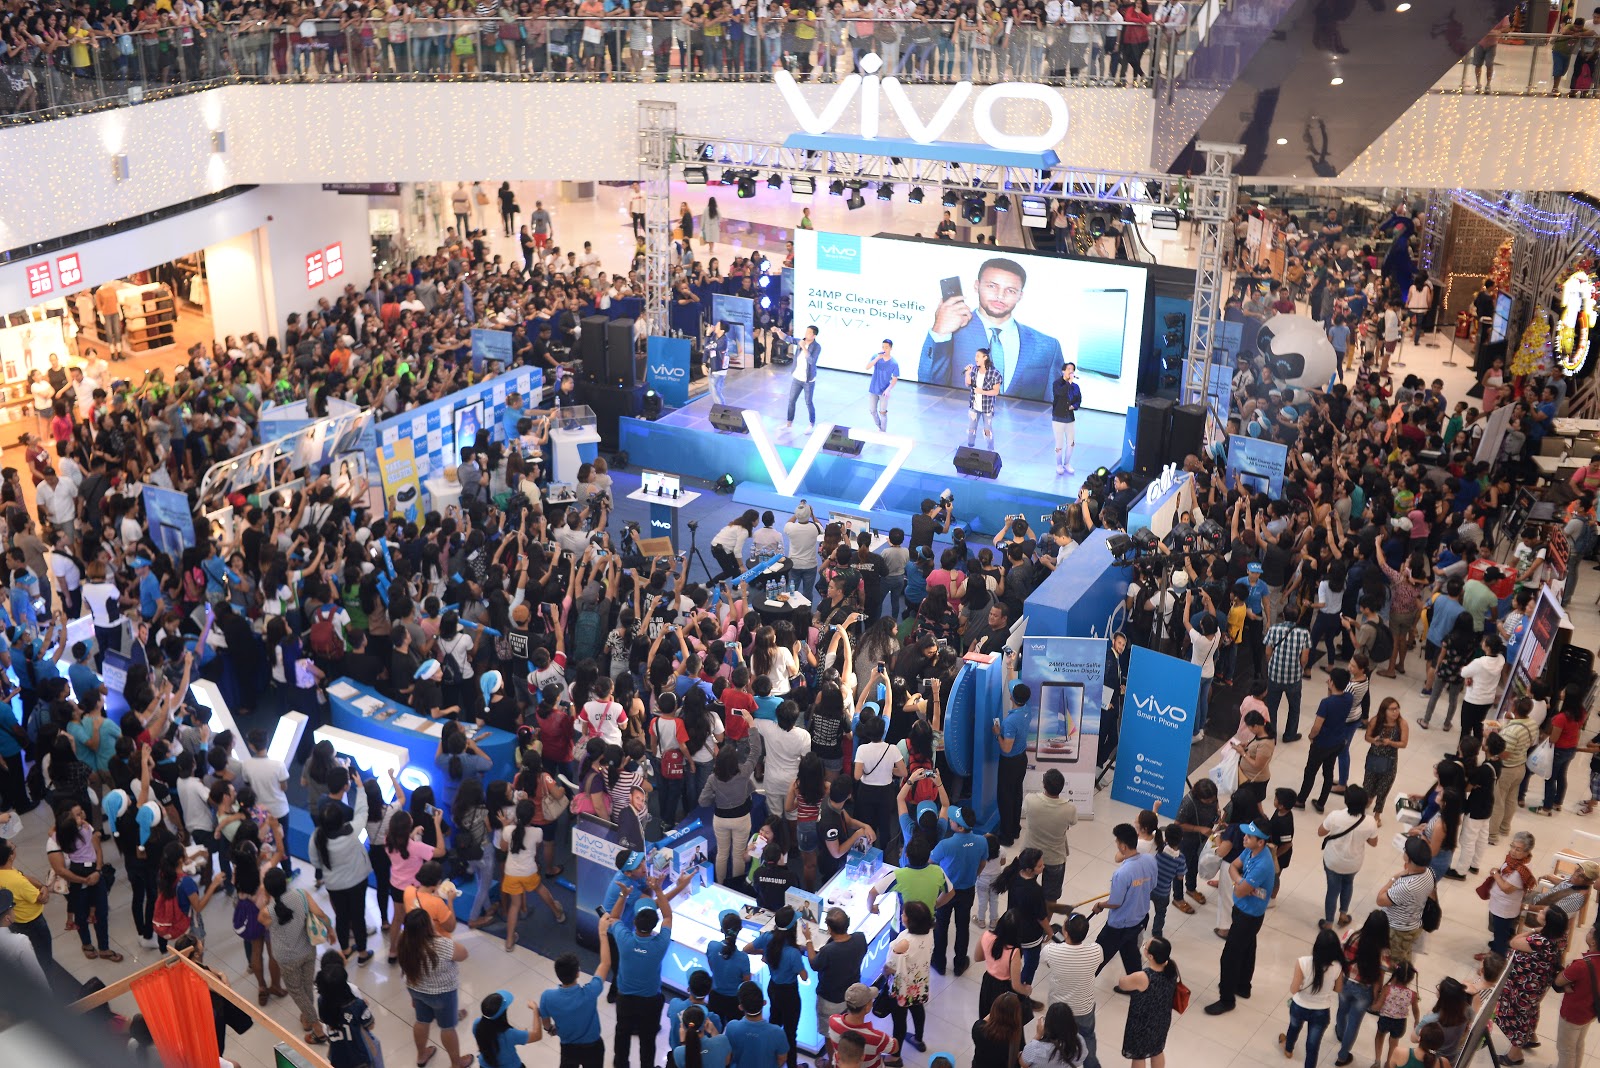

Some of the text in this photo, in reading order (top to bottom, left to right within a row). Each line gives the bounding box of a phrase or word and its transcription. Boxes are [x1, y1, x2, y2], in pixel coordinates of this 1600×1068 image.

[774, 52, 1069, 151] vivo
[808, 287, 926, 312] 24MP Clearer Selfie
[807, 300, 913, 324] All Screen Display
[650, 363, 686, 377] vivo
[741, 410, 914, 512] V7
[650, 519, 671, 530] vivo
[1061, 667, 1080, 675] Screen
[1086, 674, 1101, 682] V7
[1132, 693, 1188, 722] vivo
[1136, 709, 1180, 730] Smart Phone
[575, 832, 604, 849] vivo
